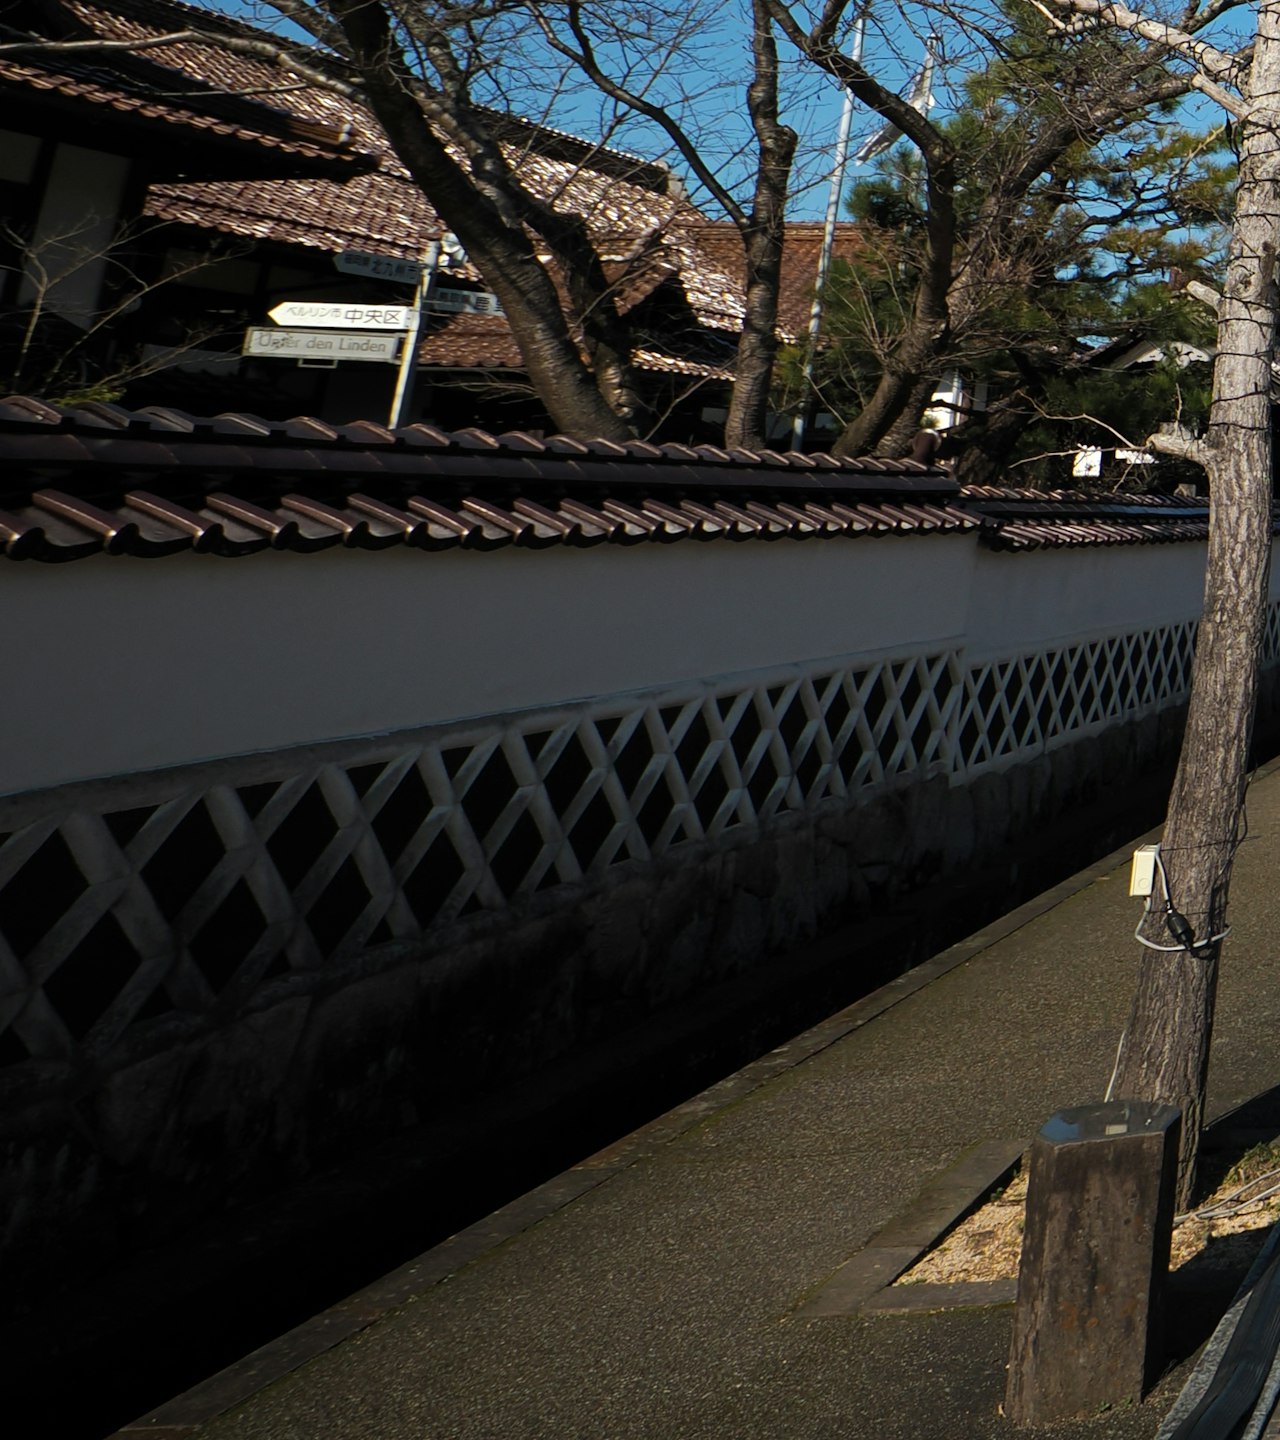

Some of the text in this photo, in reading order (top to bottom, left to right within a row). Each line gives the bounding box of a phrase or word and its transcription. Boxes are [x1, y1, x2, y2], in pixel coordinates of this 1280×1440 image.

[287, 306, 402, 325] ベルリン市 中央区
[305, 336, 333, 350] den
[339, 338, 386, 352] Linden
